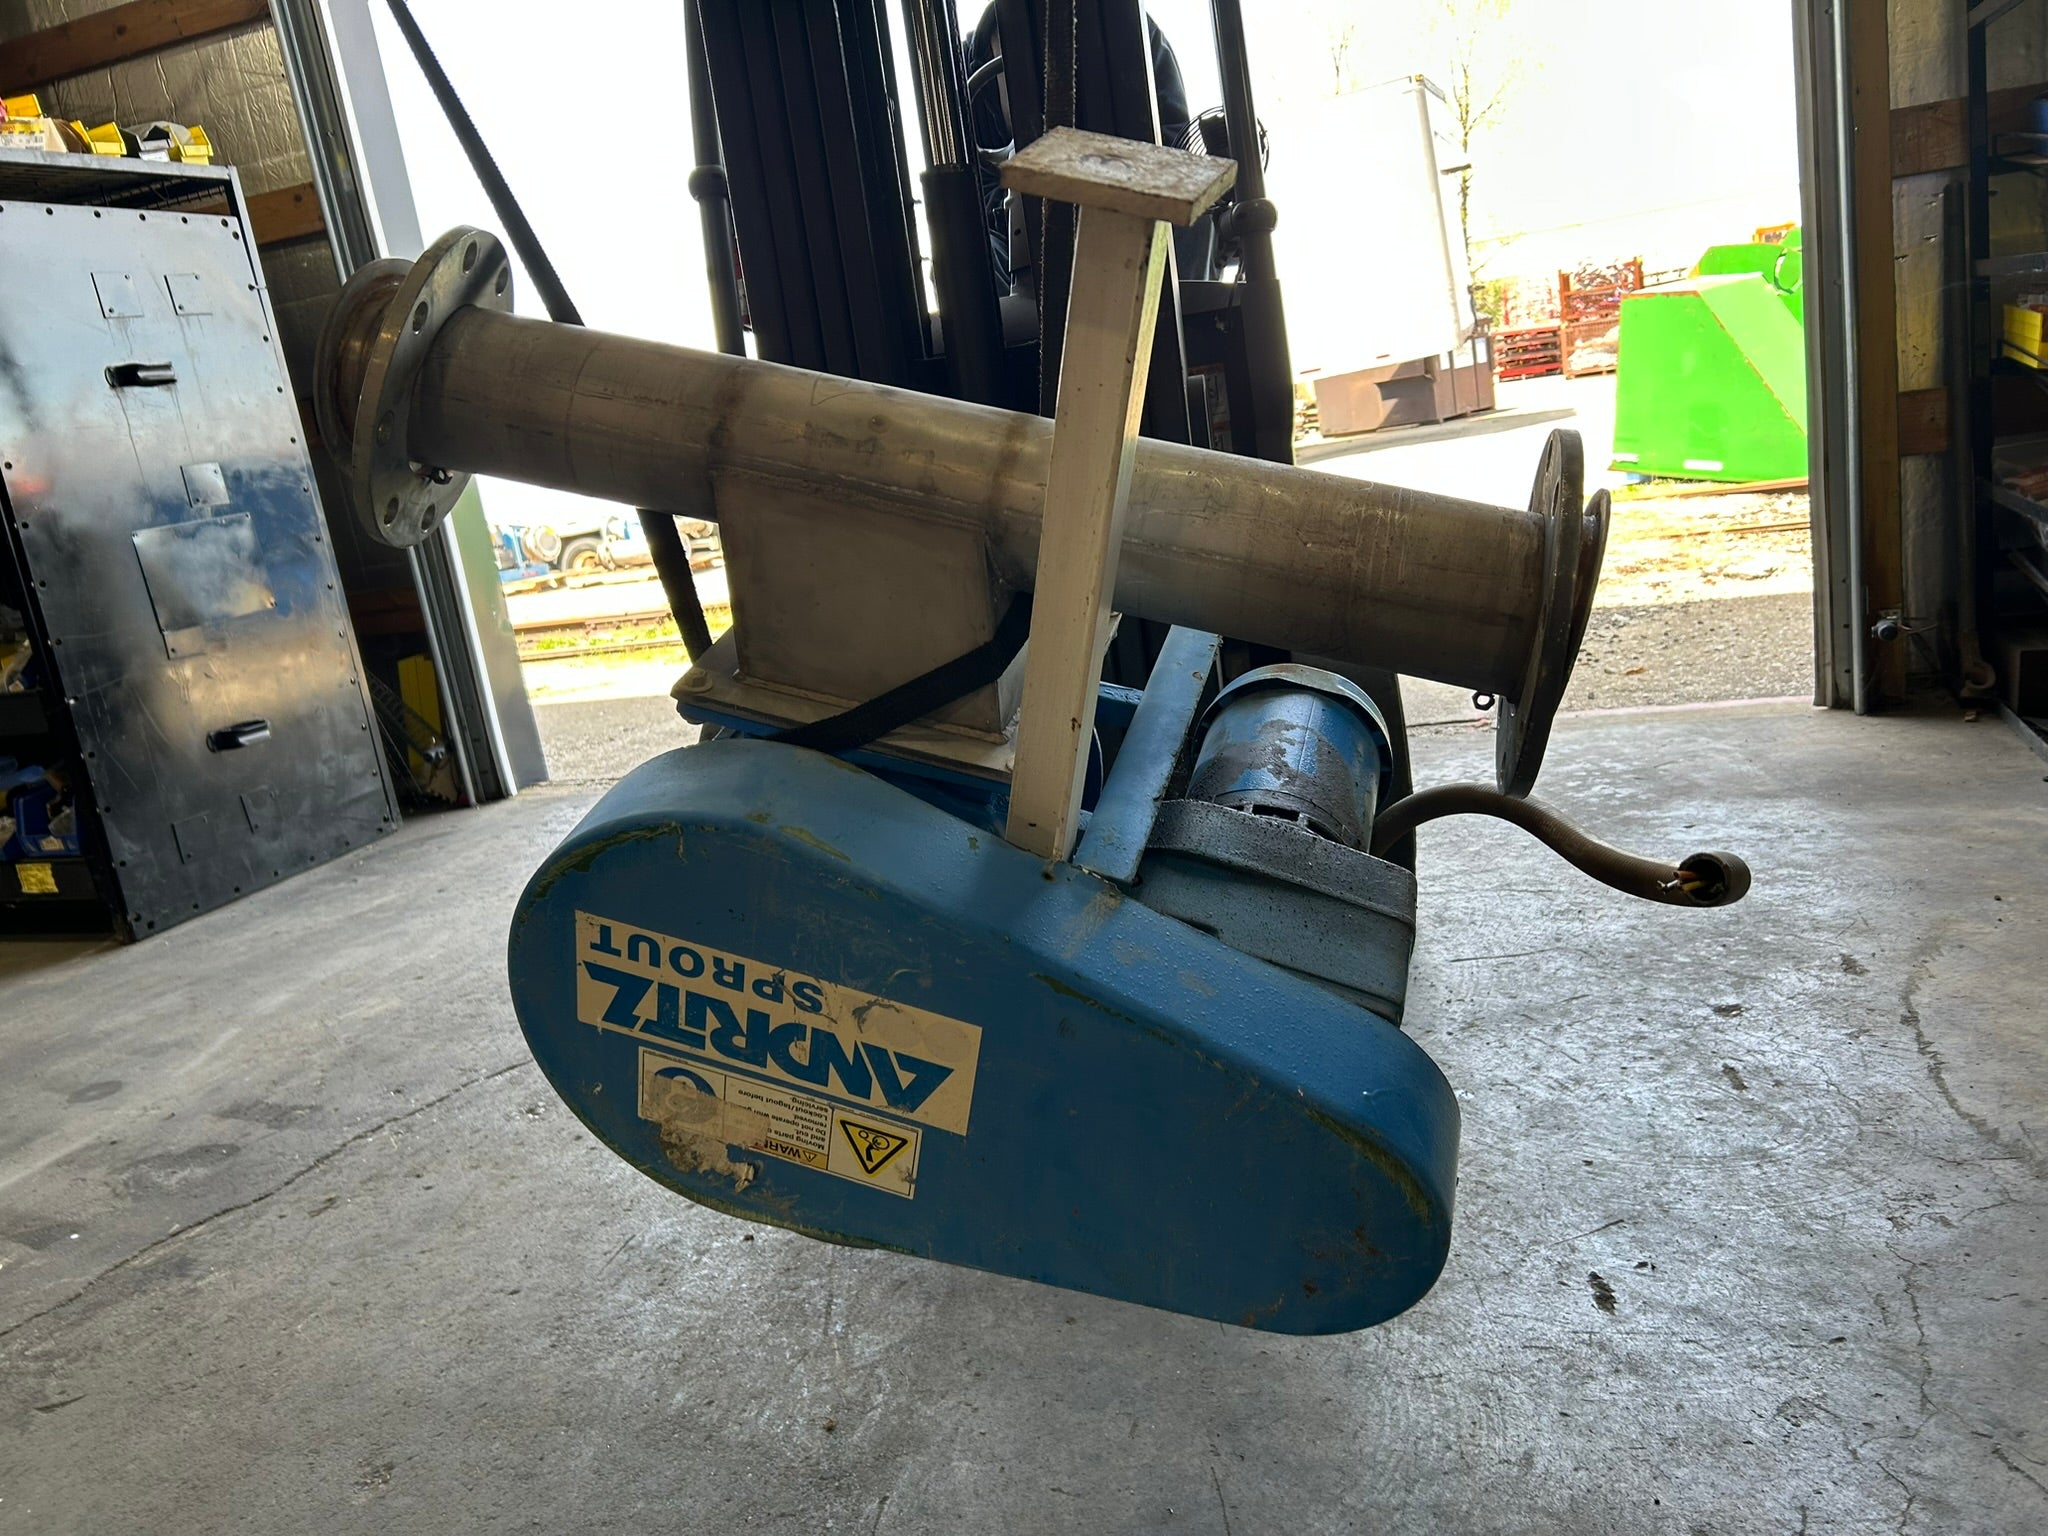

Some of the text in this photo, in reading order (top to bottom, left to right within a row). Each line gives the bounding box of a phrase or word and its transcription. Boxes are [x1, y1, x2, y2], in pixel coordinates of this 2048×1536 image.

[591, 925, 825, 1013] SPROUT
[582, 960, 953, 1113] ANDRITZ
[738, 1090, 764, 1102] before
[772, 1115, 799, 1126] operate
[774, 1130, 794, 1140] parts
[811, 1134, 825, 1142] and
[796, 1136, 824, 1150] Moving
